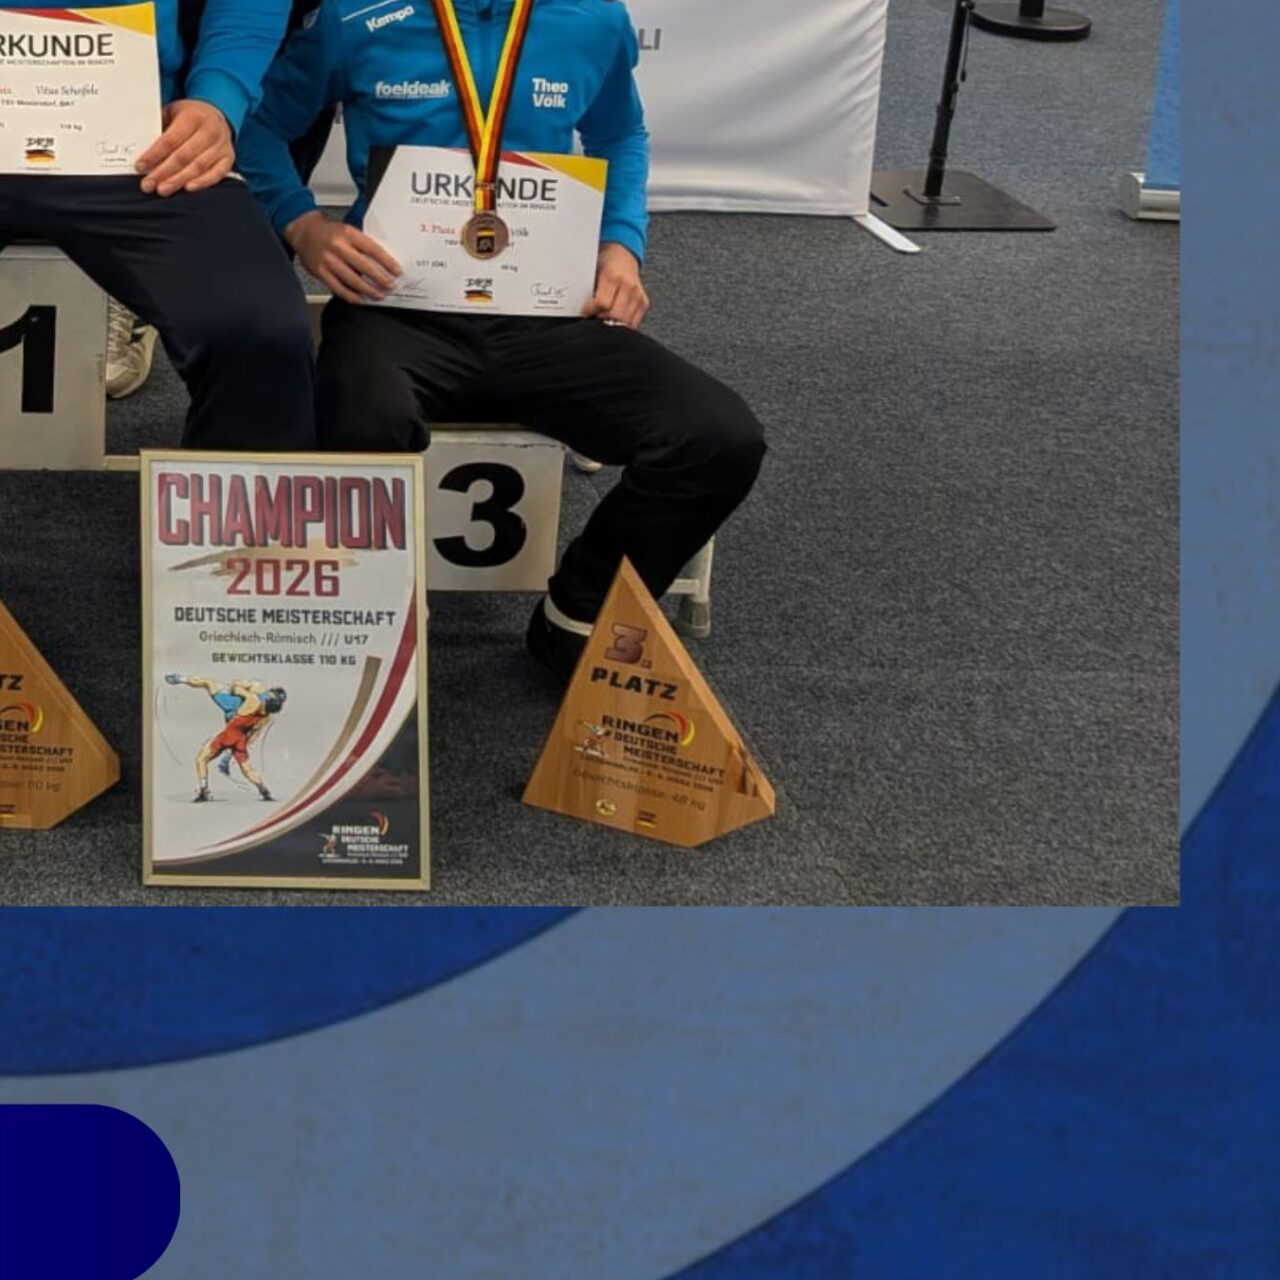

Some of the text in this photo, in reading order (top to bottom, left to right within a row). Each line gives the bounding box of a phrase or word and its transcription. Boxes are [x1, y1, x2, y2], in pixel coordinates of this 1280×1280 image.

[366, 5, 415, 32] Kempa
[376, 80, 450, 99] foeldeak
[532, 78, 568, 93] Theo
[533, 90, 567, 107] Völk
[411, 172, 558, 202] URKNDE
[158, 472, 406, 551] CHAMPION
[433, 463, 527, 568] 3
[225, 556, 341, 597] 2026
[175, 607, 395, 625] DEUTSCHE MEISTERSCHAFT
[200, 631, 316, 644] Griechisch-Römisch
[344, 635, 368, 644] U17
[605, 623, 652, 669] 3.
[212, 653, 314, 664] GEWICHTSKLASSE
[319, 655, 337, 665] 110
[590, 667, 677, 701] PLATZ
[602, 714, 679, 743] RINGEN
[623, 745, 725, 778] MEISTERSCHAFT
